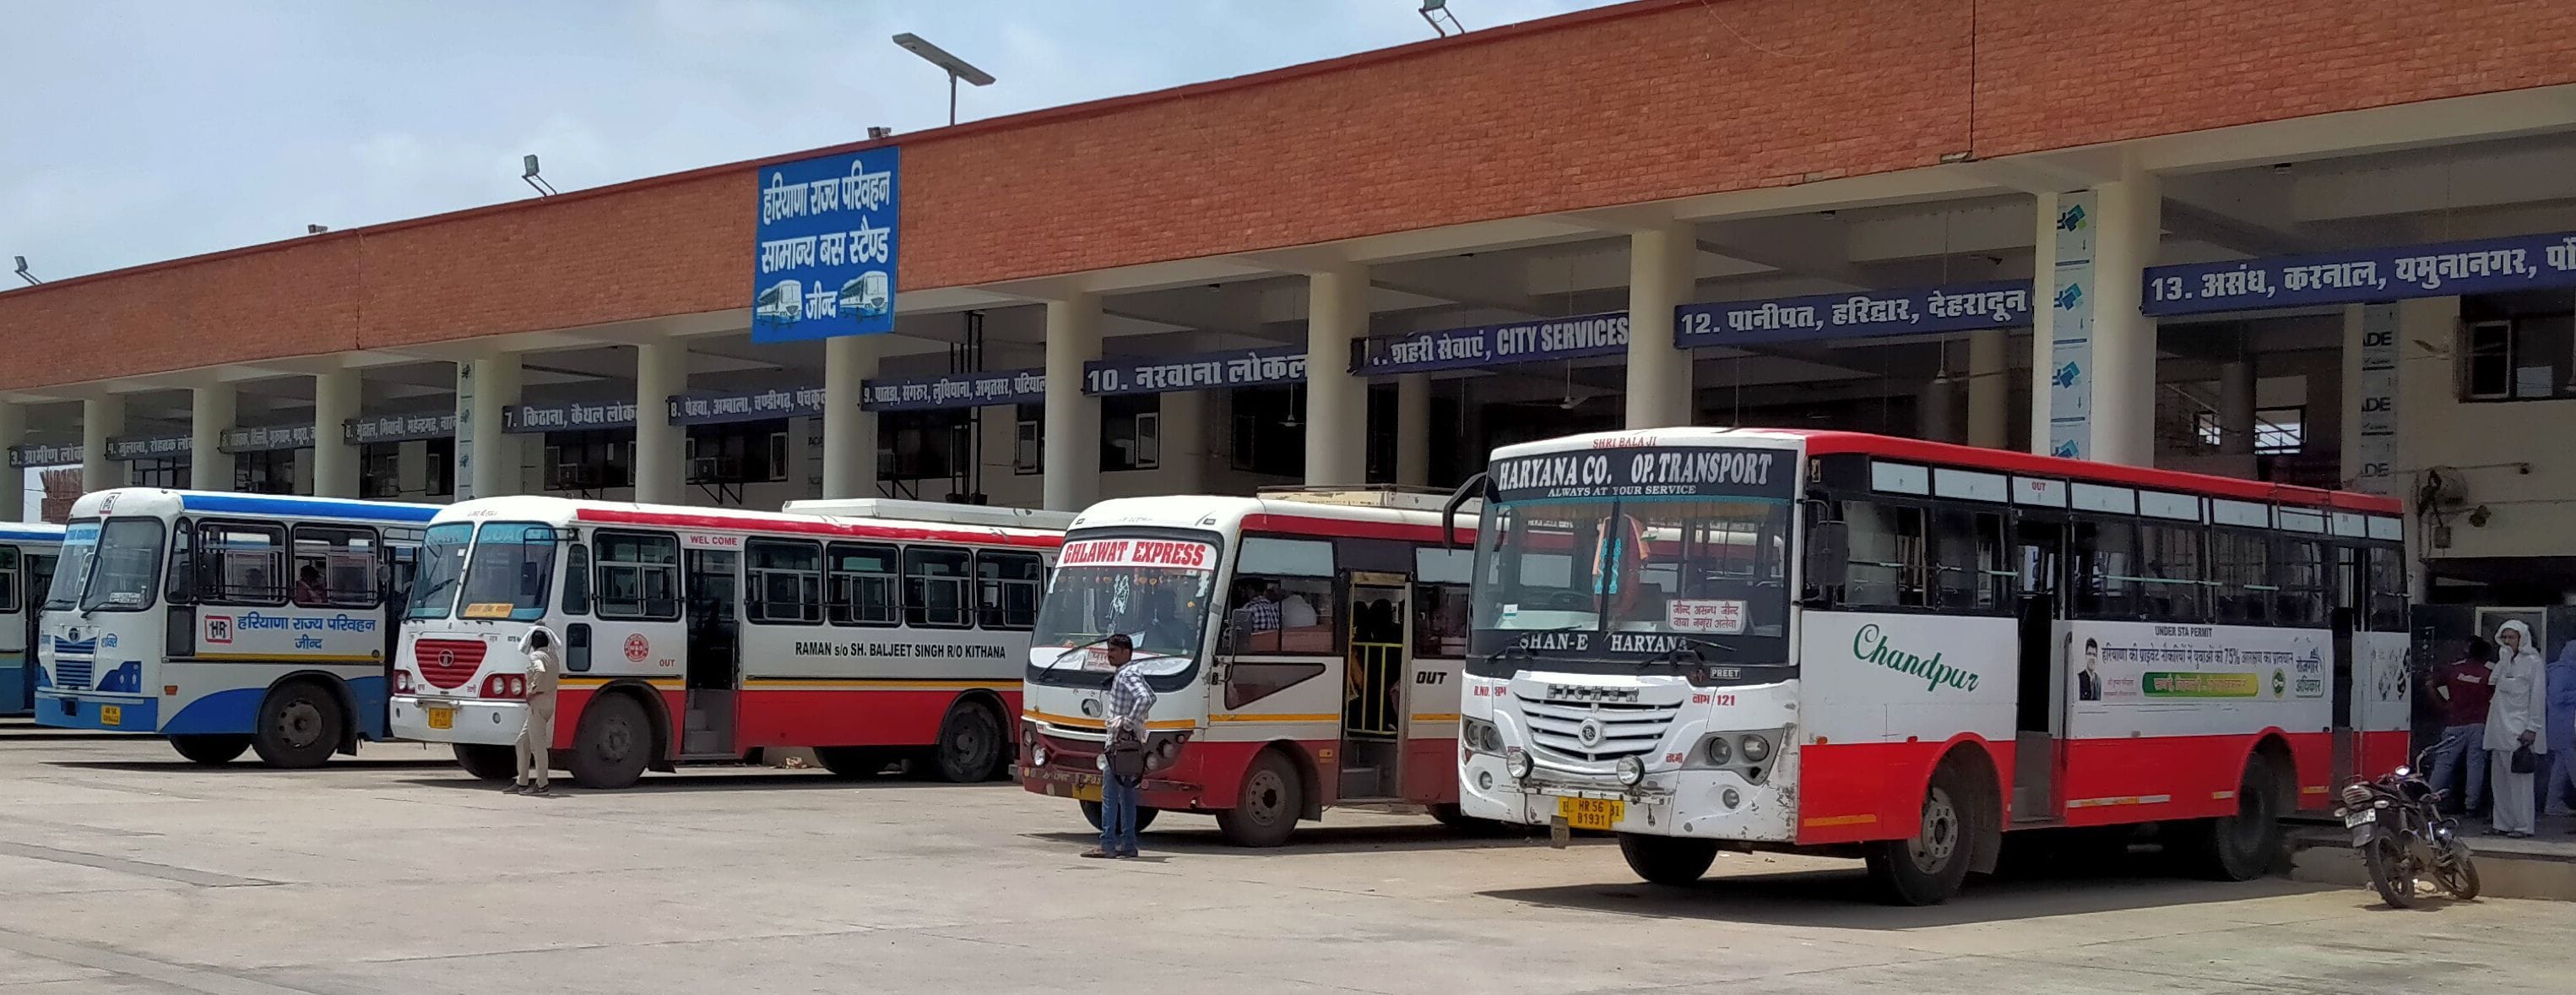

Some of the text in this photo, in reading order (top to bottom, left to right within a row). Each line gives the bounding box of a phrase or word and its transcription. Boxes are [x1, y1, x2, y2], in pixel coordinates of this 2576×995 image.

[763, 159, 891, 225] हरियाणा राज्य परिवहन
[762, 236, 816, 274] सामान्य
[820, 231, 846, 266] बस
[2150, 276, 2193, 302] 13.
[2200, 263, 2275, 299] असंध,
[2283, 260, 2386, 291] करनाल,
[2394, 247, 2537, 291] यमुनानगर,
[805, 280, 838, 320] जीन्द
[1681, 290, 2026, 334] 12. पानीपत, हरिद्वार, देहरादून
[1391, 335, 1434, 364] शहरी
[1496, 326, 1537, 356] CITY
[1540, 317, 1629, 353] SERVICES
[1087, 368, 1129, 392] 10.
[1135, 361, 1222, 389] नरवाना
[975, 378, 1012, 400] अमृतसर,
[505, 411, 517, 427] 7.
[1593, 435, 1657, 449] SHRI BALA JI
[10, 451, 21, 465] 3.
[24, 445, 58, 465] ग्रामीण
[1498, 452, 1773, 492] HARYANA CO. OP. TRANSPORT
[1548, 485, 1697, 498] ALWAYS AT YOUR SERVICE
[2031, 481, 2047, 492] OUT
[690, 535, 738, 546] WEL COME
[1131, 541, 1207, 567] EXPRESS
[210, 622, 226, 638] HR
[237, 611, 377, 633] हरियाणा राज्य परिवहन
[2155, 626, 2212, 638] UNDER STA PERMIT
[294, 633, 323, 650] जीन्द
[795, 642, 1006, 659] RAMAN s/o SH. BALJEET SINGH R/O KITHANA
[1520, 633, 1688, 653] SHAN-E HARYANA
[659, 659, 675, 667] OUT
[1853, 623, 1979, 692] Chandpur
[2224, 648, 2240, 665] 75%
[1416, 671, 1447, 684] OUT
[1711, 669, 1739, 677] PREET
[1547, 684, 1639, 703] EICHER
[1717, 695, 1735, 706] 121
[1579, 800, 1589, 812] HR
[1592, 801, 1603, 813] 56
